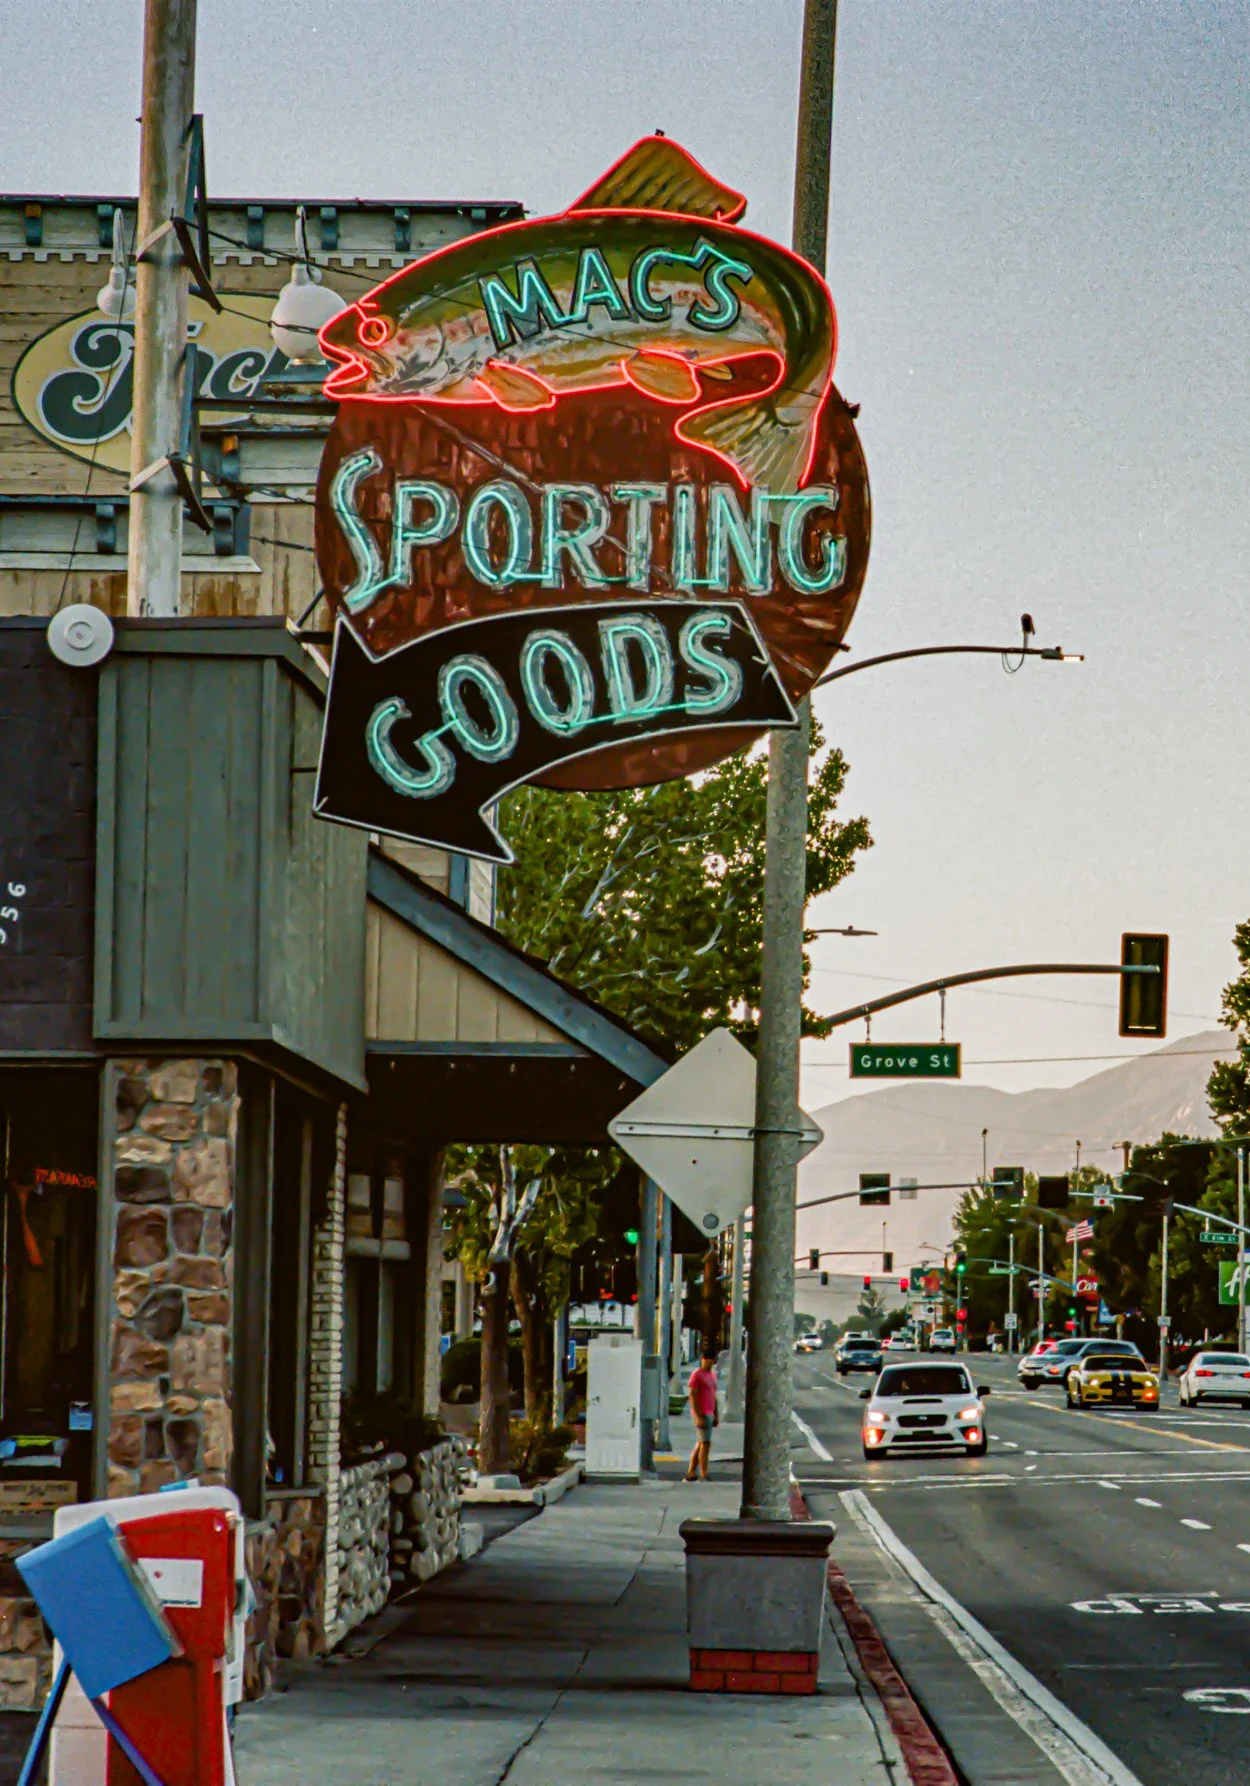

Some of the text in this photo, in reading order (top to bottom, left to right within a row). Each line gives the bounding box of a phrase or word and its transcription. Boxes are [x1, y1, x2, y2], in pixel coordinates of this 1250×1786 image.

[478, 239, 754, 352] MAC'S
[328, 445, 848, 613] SPORTING
[366, 613, 742, 800] GOODS
[860, 1055, 950, 1068] Grove St
